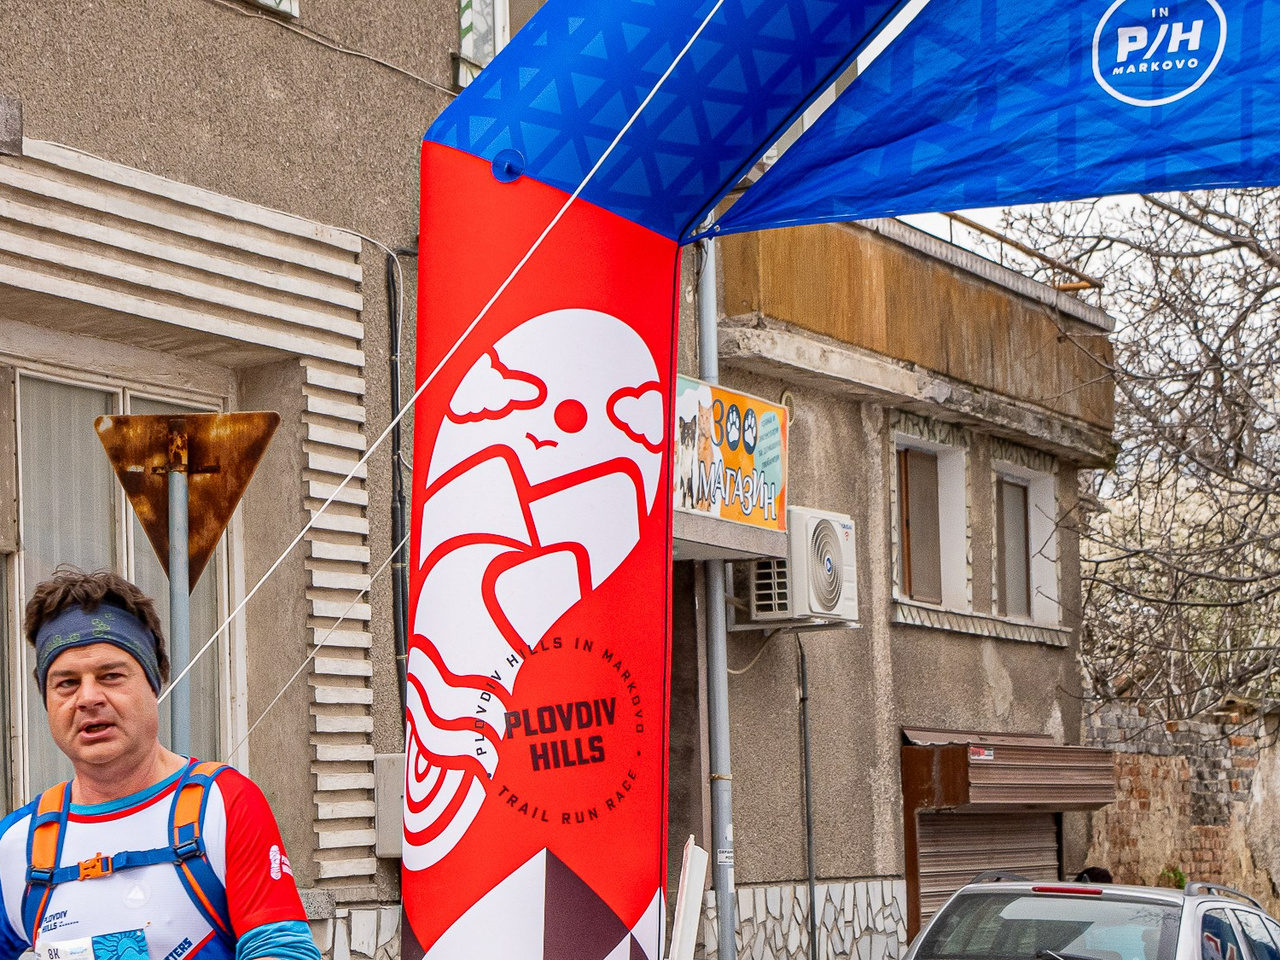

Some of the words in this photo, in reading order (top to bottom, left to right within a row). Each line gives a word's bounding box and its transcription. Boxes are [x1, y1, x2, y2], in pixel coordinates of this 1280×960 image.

[1151, 7, 1169, 18] IN
[1116, 19, 1204, 63] P/H
[1112, 58, 1199, 76] MARKOVO
[697, 459, 777, 521] МАГАЗИН
[474, 669, 503, 757] PLOVDIV
[506, 636, 563, 668] HILLS
[574, 637, 594, 653] IN
[601, 649, 644, 734] MARKOVO
[504, 697, 616, 740] PLOVDIV
[529, 735, 606, 772] HILLS
[498, 785, 550, 823] TRAIL
[562, 808, 599, 825] RUN
[606, 769, 638, 812] RACE
[47, 948, 61, 960] 8K
